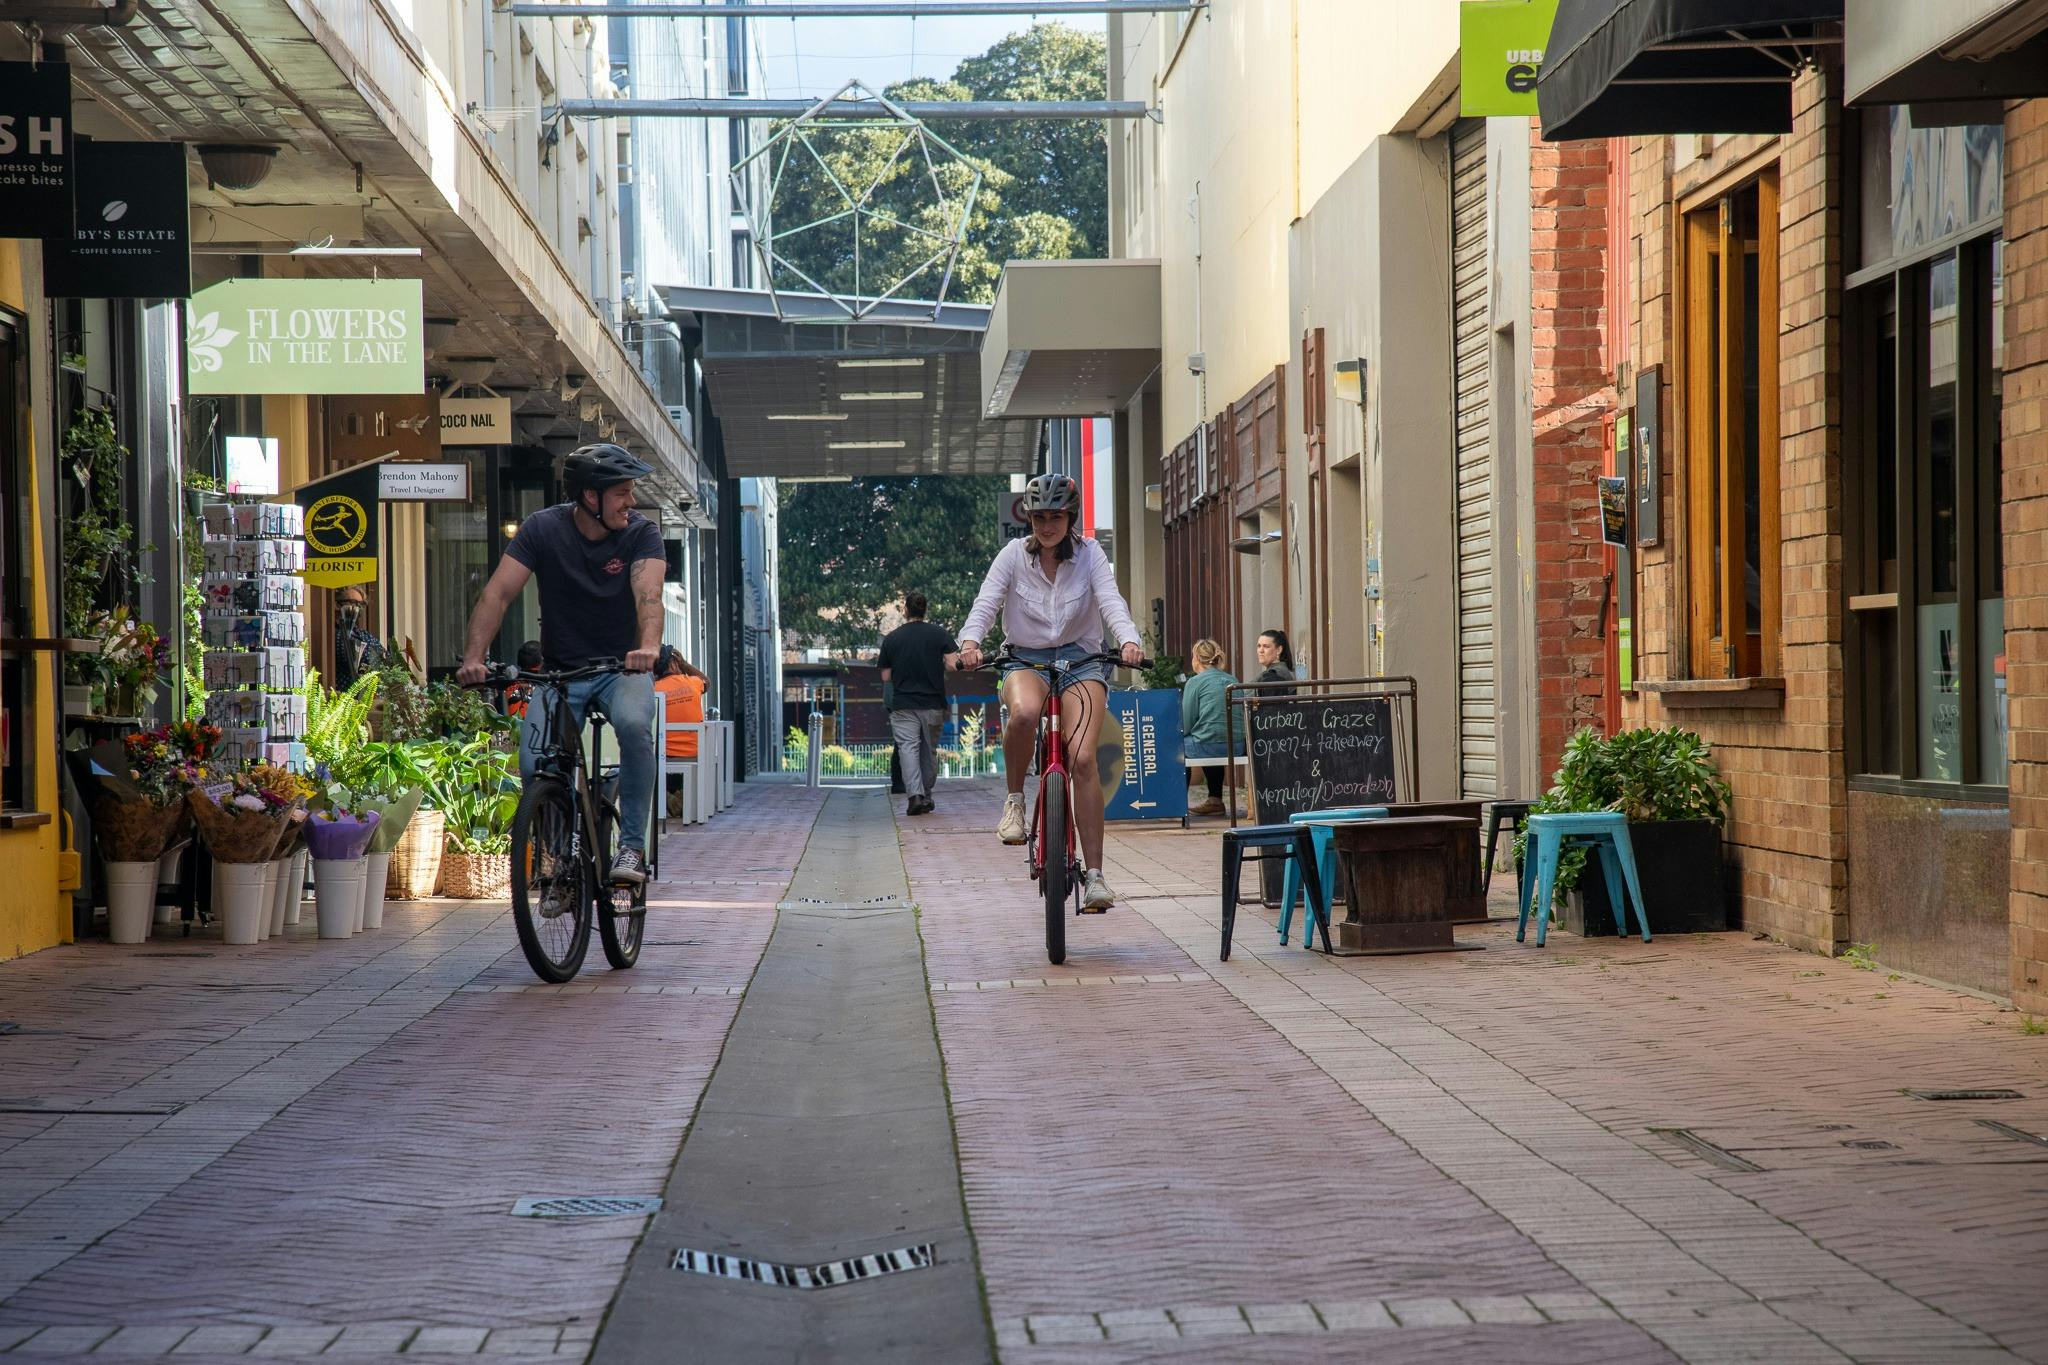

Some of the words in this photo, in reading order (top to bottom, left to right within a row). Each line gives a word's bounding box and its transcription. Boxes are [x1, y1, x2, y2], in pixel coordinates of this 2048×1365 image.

[1505, 49, 1544, 64] URB
[0, 115, 64, 156] SH
[42, 161, 64, 173] bar
[32, 174, 64, 186] bites
[78, 230, 112, 240] BY'S
[117, 230, 176, 240] ESTATE
[246, 308, 408, 340] FLOWERS
[247, 342, 273, 364] IN
[284, 342, 332, 364] THE
[343, 342, 408, 364] LANE
[440, 414, 467, 429] COCO
[471, 413, 495, 428] NAIL
[420, 471, 459, 483] Mahony
[389, 486, 411, 494] Travel
[413, 486, 446, 495] Designer
[313, 494, 359, 510] INTERFLORA
[1001, 522, 1026, 538] Tar
[305, 528, 327, 552] FLOWERS
[304, 561, 365, 573] FLORIST
[1322, 707, 1377, 729] Graze
[1122, 709, 1138, 786] TEMPERANCE
[1142, 724, 1157, 776] GENERAL
[1301, 733, 1313, 752] 4
[1317, 732, 1385, 754] takeaway
[1311, 759, 1321, 777] &
